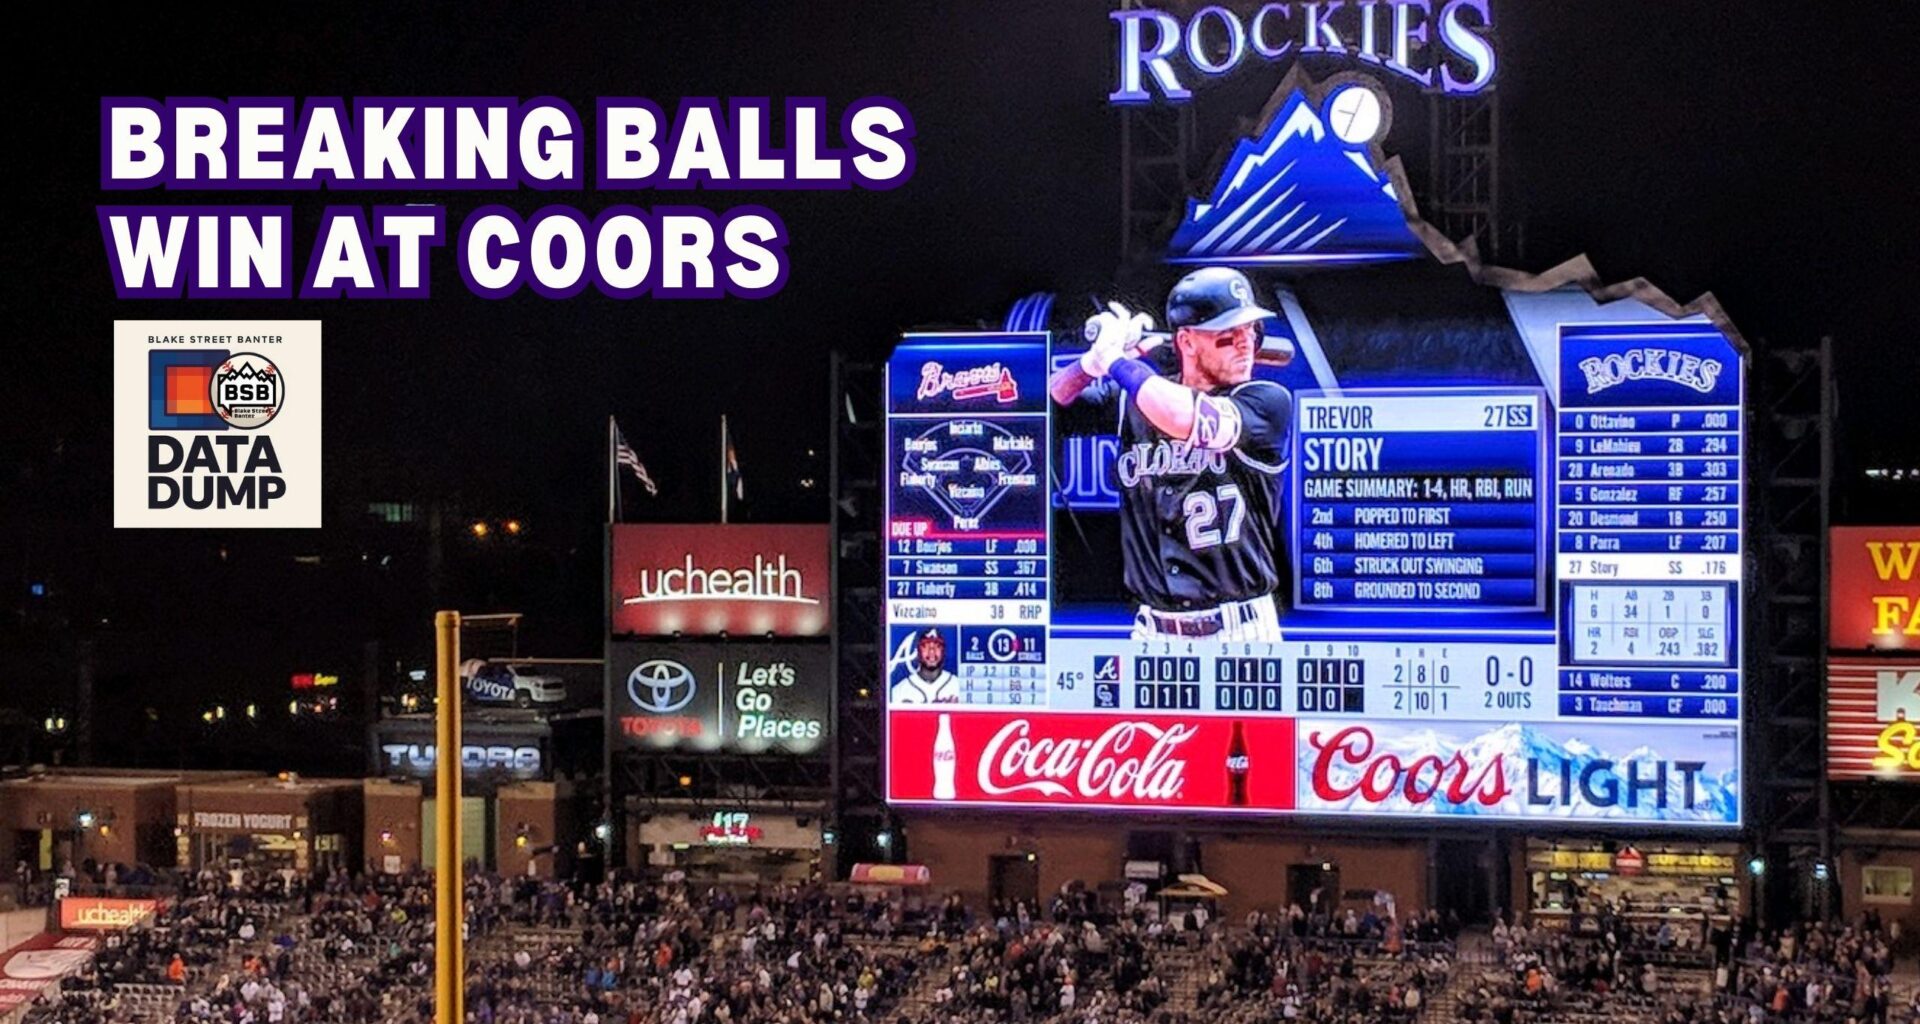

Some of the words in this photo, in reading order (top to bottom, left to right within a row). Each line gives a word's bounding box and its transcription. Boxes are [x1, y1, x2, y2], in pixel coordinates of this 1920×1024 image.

[1109, 0, 1497, 101] ROCKIES
[1578, 348, 1723, 394] ROCKIES
[917, 361, 1001, 400] Braves
[1306, 406, 1373, 429] TREVOR
[1484, 405, 1503, 427] 27
[1509, 405, 1528, 424] SS
[1575, 414, 1583, 429] 0
[1671, 414, 1680, 429] P
[1304, 437, 1384, 472] STORY
[1304, 479, 1343, 498] GAME
[1346, 478, 1418, 498] SUMMARY:
[1423, 478, 1447, 499] 1-4,
[1450, 479, 1472, 500] HR,
[1475, 479, 1502, 500] RBI,
[1505, 479, 1533, 497] RUN
[1575, 487, 1583, 502] 5
[1668, 487, 1683, 502] RF
[1183, 484, 1246, 550] 27
[1312, 508, 1333, 525] 2nd
[1354, 508, 1400, 525] POPPED
[1402, 508, 1416, 525] TO
[1418, 508, 1450, 525] FIRST
[1568, 511, 1583, 526] 20
[1668, 511, 1683, 526] 1B
[1701, 510, 1727, 526] .250
[891, 522, 912, 537] DUE
[915, 522, 928, 537] UP
[898, 540, 910, 554] 12
[985, 540, 998, 554] LF
[1313, 532, 1333, 549] 4th
[1354, 532, 1409, 549] HOMERED
[1411, 533, 1425, 549] TO
[1427, 533, 1455, 550] LEFT
[1575, 535, 1583, 550] 8
[1590, 535, 1620, 550] Parra
[1668, 535, 1682, 550] LF
[1701, 534, 1727, 550] .207
[903, 561, 910, 574] 7
[984, 561, 998, 575] SS
[1313, 557, 1333, 574] 6th
[1354, 557, 1400, 574] STRUCK
[1402, 557, 1424, 574] OUT
[1425, 557, 1483, 575] SWINGING
[1569, 561, 1582, 574] 27
[1590, 561, 1618, 576] Story
[1669, 561, 1682, 574] SS
[641, 554, 801, 598] uchealth
[897, 582, 910, 596] 27
[1014, 582, 1037, 597] .414
[1313, 582, 1333, 599] 8th
[1354, 582, 1415, 599] GROUNDED
[1417, 582, 1432, 599] TO
[1434, 582, 1481, 599] SECOND
[893, 604, 937, 618] Vizcaino
[1019, 605, 1042, 619] RHP
[1590, 604, 1597, 618] 6
[1624, 604, 1638, 618] 34
[1666, 605, 1670, 618] 1
[971, 637, 979, 651] 2
[997, 638, 1009, 652] 13
[1024, 638, 1035, 651] 11
[1590, 641, 1598, 655] 2
[1627, 641, 1634, 655] 4
[1655, 642, 1680, 656] .243
[736, 662, 796, 686] Let's
[1394, 664, 1403, 683] 2
[1417, 664, 1426, 684] 8
[1441, 665, 1449, 684] 0
[1569, 673, 1582, 687] 14
[1671, 674, 1679, 689] C
[466, 676, 516, 700] TOYOTA
[736, 688, 772, 711] Go
[1394, 691, 1403, 710] 2
[1416, 691, 1429, 710] 10
[1484, 691, 1492, 708] 2
[1497, 691, 1532, 709] OUTS
[1575, 697, 1582, 711] 3
[1668, 699, 1683, 713] CF
[620, 716, 705, 737] TOYOTA
[737, 716, 821, 738] Places
[382, 744, 541, 769] TUDRA
[977, 719, 1199, 799] Coca-Cola
[1309, 726, 1511, 806] Coors
[1527, 758, 1706, 809] LIGHT
[194, 812, 241, 828] FROZEN
[243, 814, 292, 829] YOGURT
